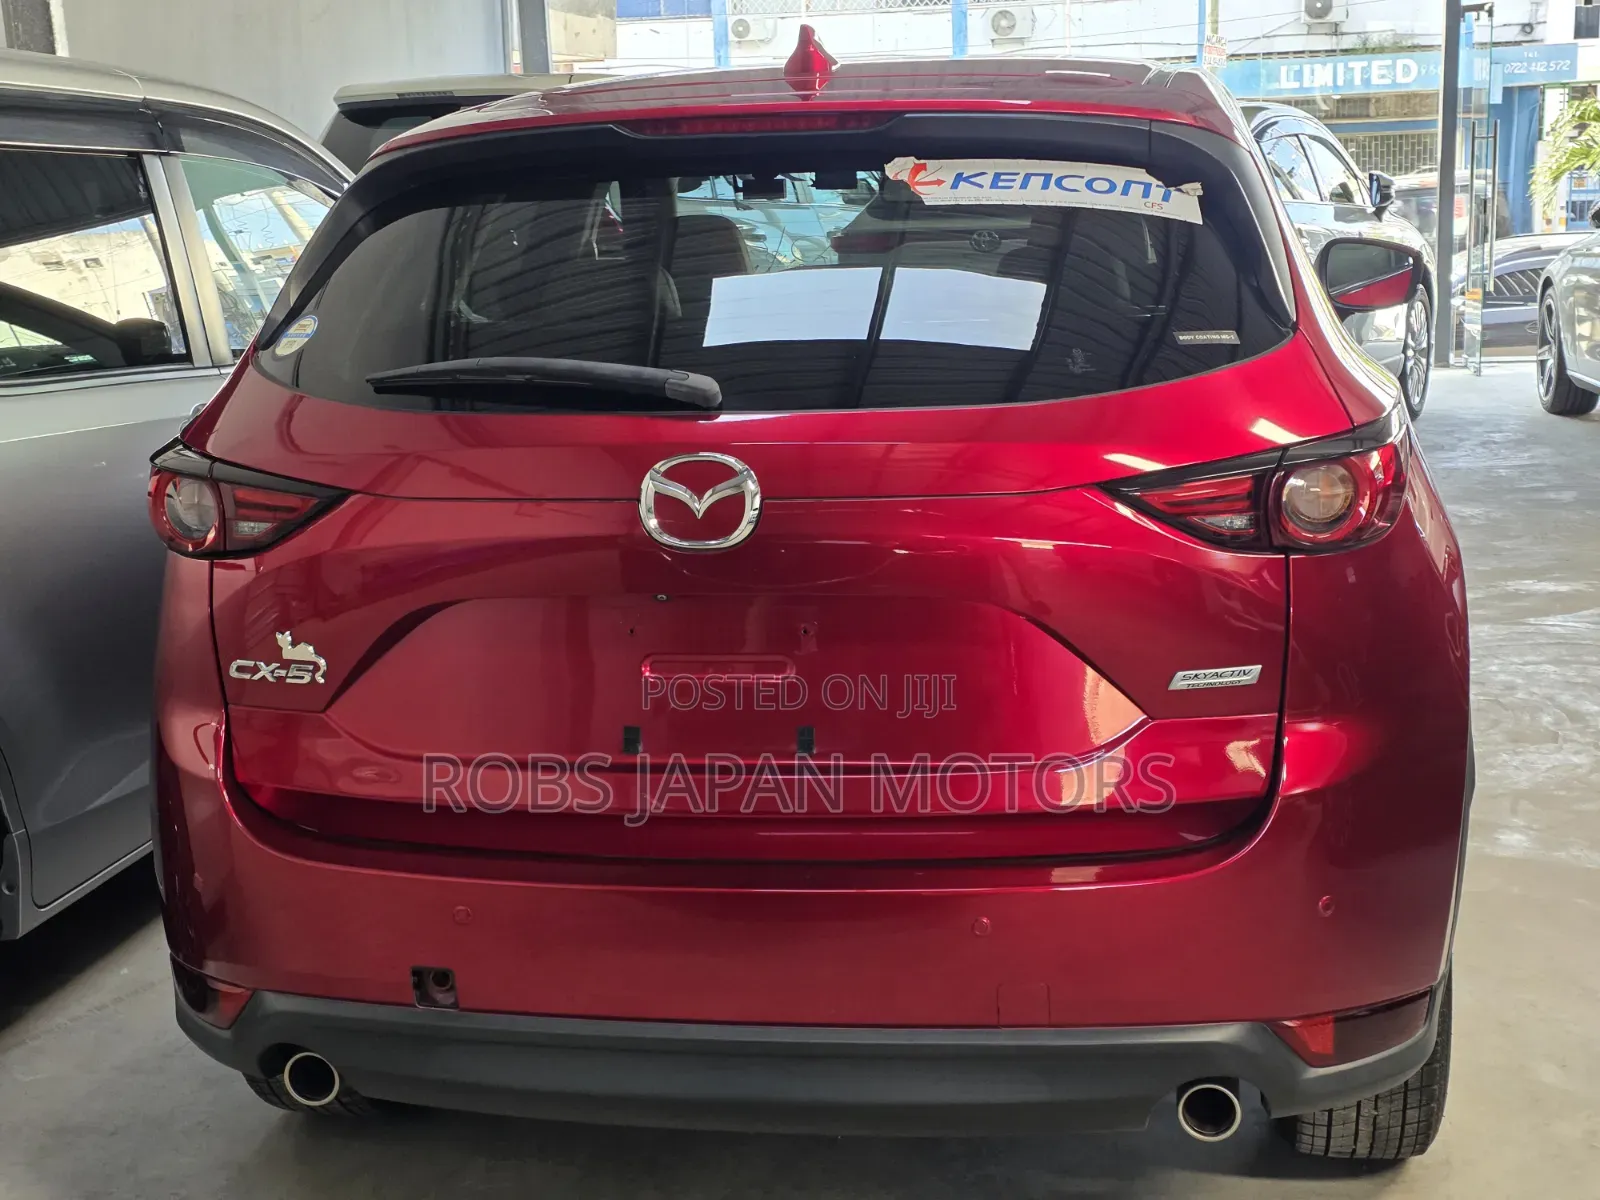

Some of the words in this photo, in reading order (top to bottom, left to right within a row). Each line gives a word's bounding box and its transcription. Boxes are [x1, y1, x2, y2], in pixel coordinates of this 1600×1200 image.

[1280, 58, 1418, 89] LIMITED
[1143, 201, 1164, 211] CFS
[229, 659, 314, 684] CX-5
[1181, 668, 1254, 681] SKYACTIV
[1186, 680, 1243, 688] TECHNOLOGY
